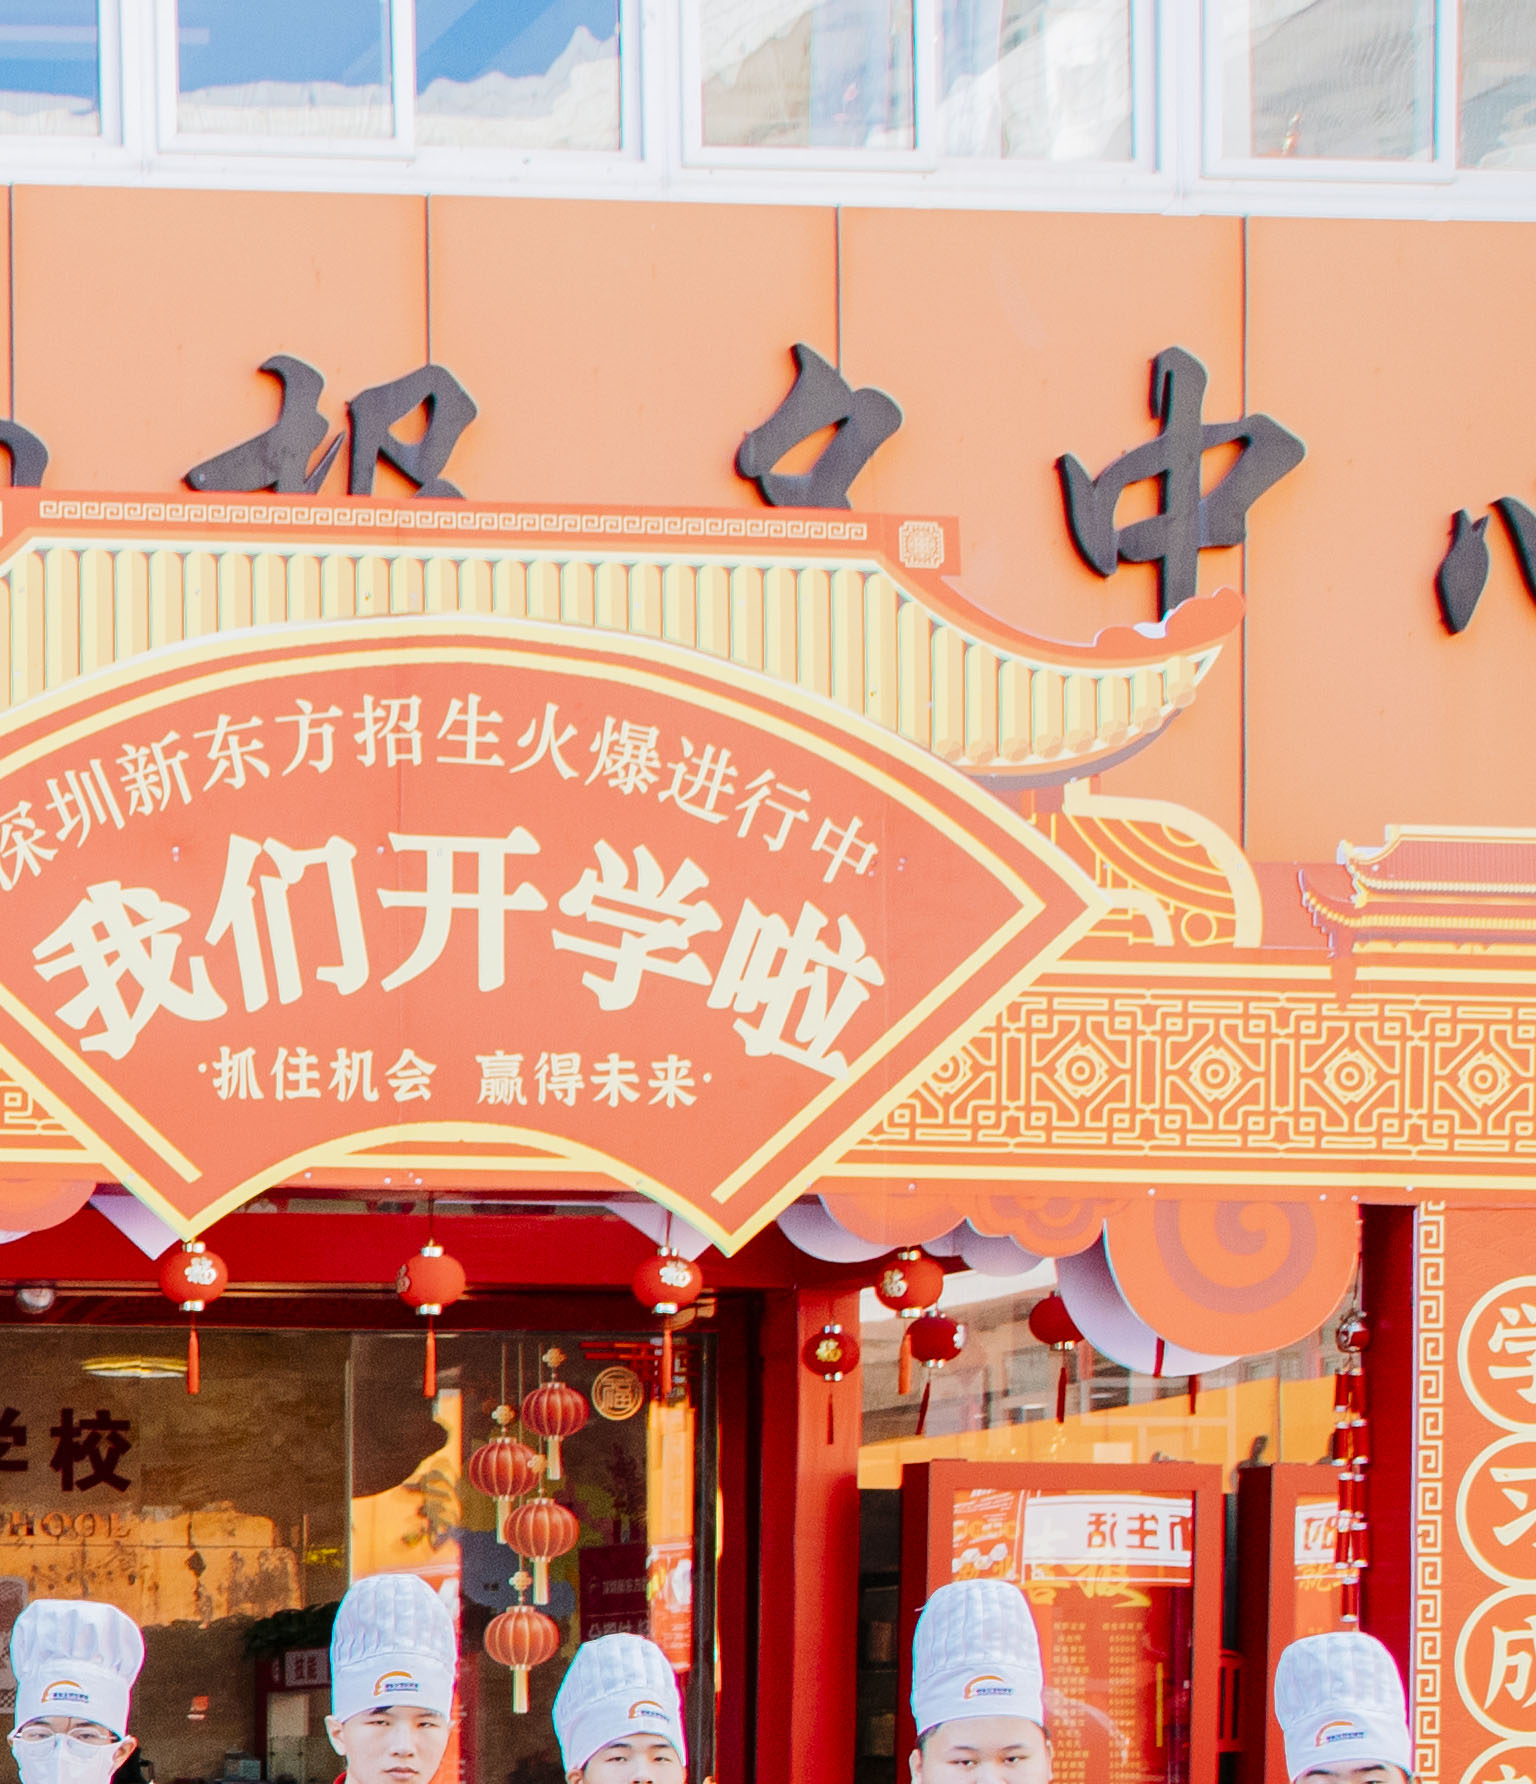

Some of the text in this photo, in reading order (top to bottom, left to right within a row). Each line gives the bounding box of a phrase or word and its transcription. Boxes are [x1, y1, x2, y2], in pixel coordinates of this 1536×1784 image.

[29, 822, 892, 1091] 我们开学啦
